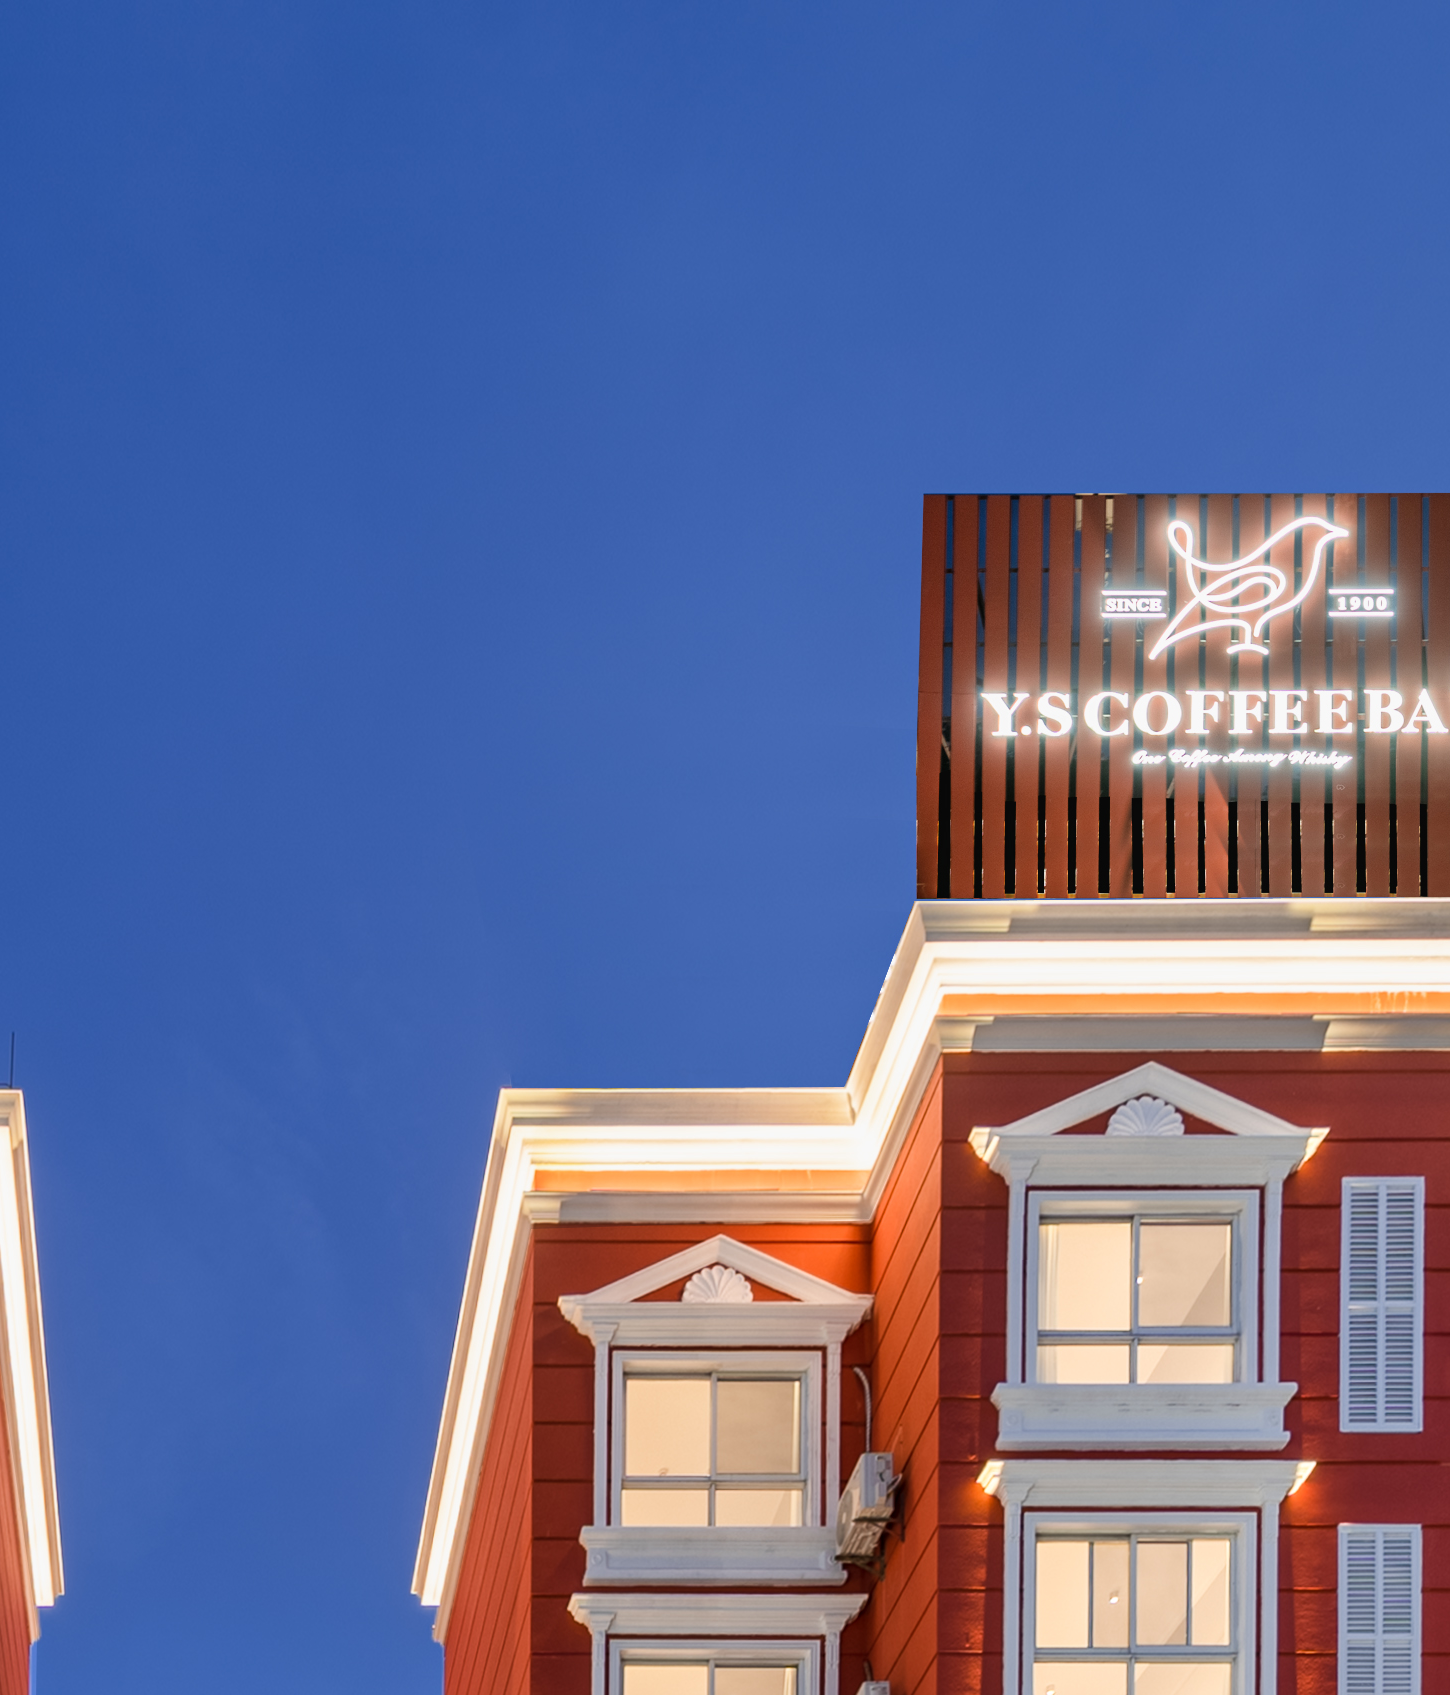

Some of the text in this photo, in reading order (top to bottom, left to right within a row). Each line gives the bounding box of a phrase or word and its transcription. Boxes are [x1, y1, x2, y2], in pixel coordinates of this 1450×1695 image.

[1105, 597, 1163, 612] SINCE
[1338, 595, 1388, 612] 1900
[981, 692, 1074, 737] Y.S
[1084, 688, 1354, 736] COFFEE
